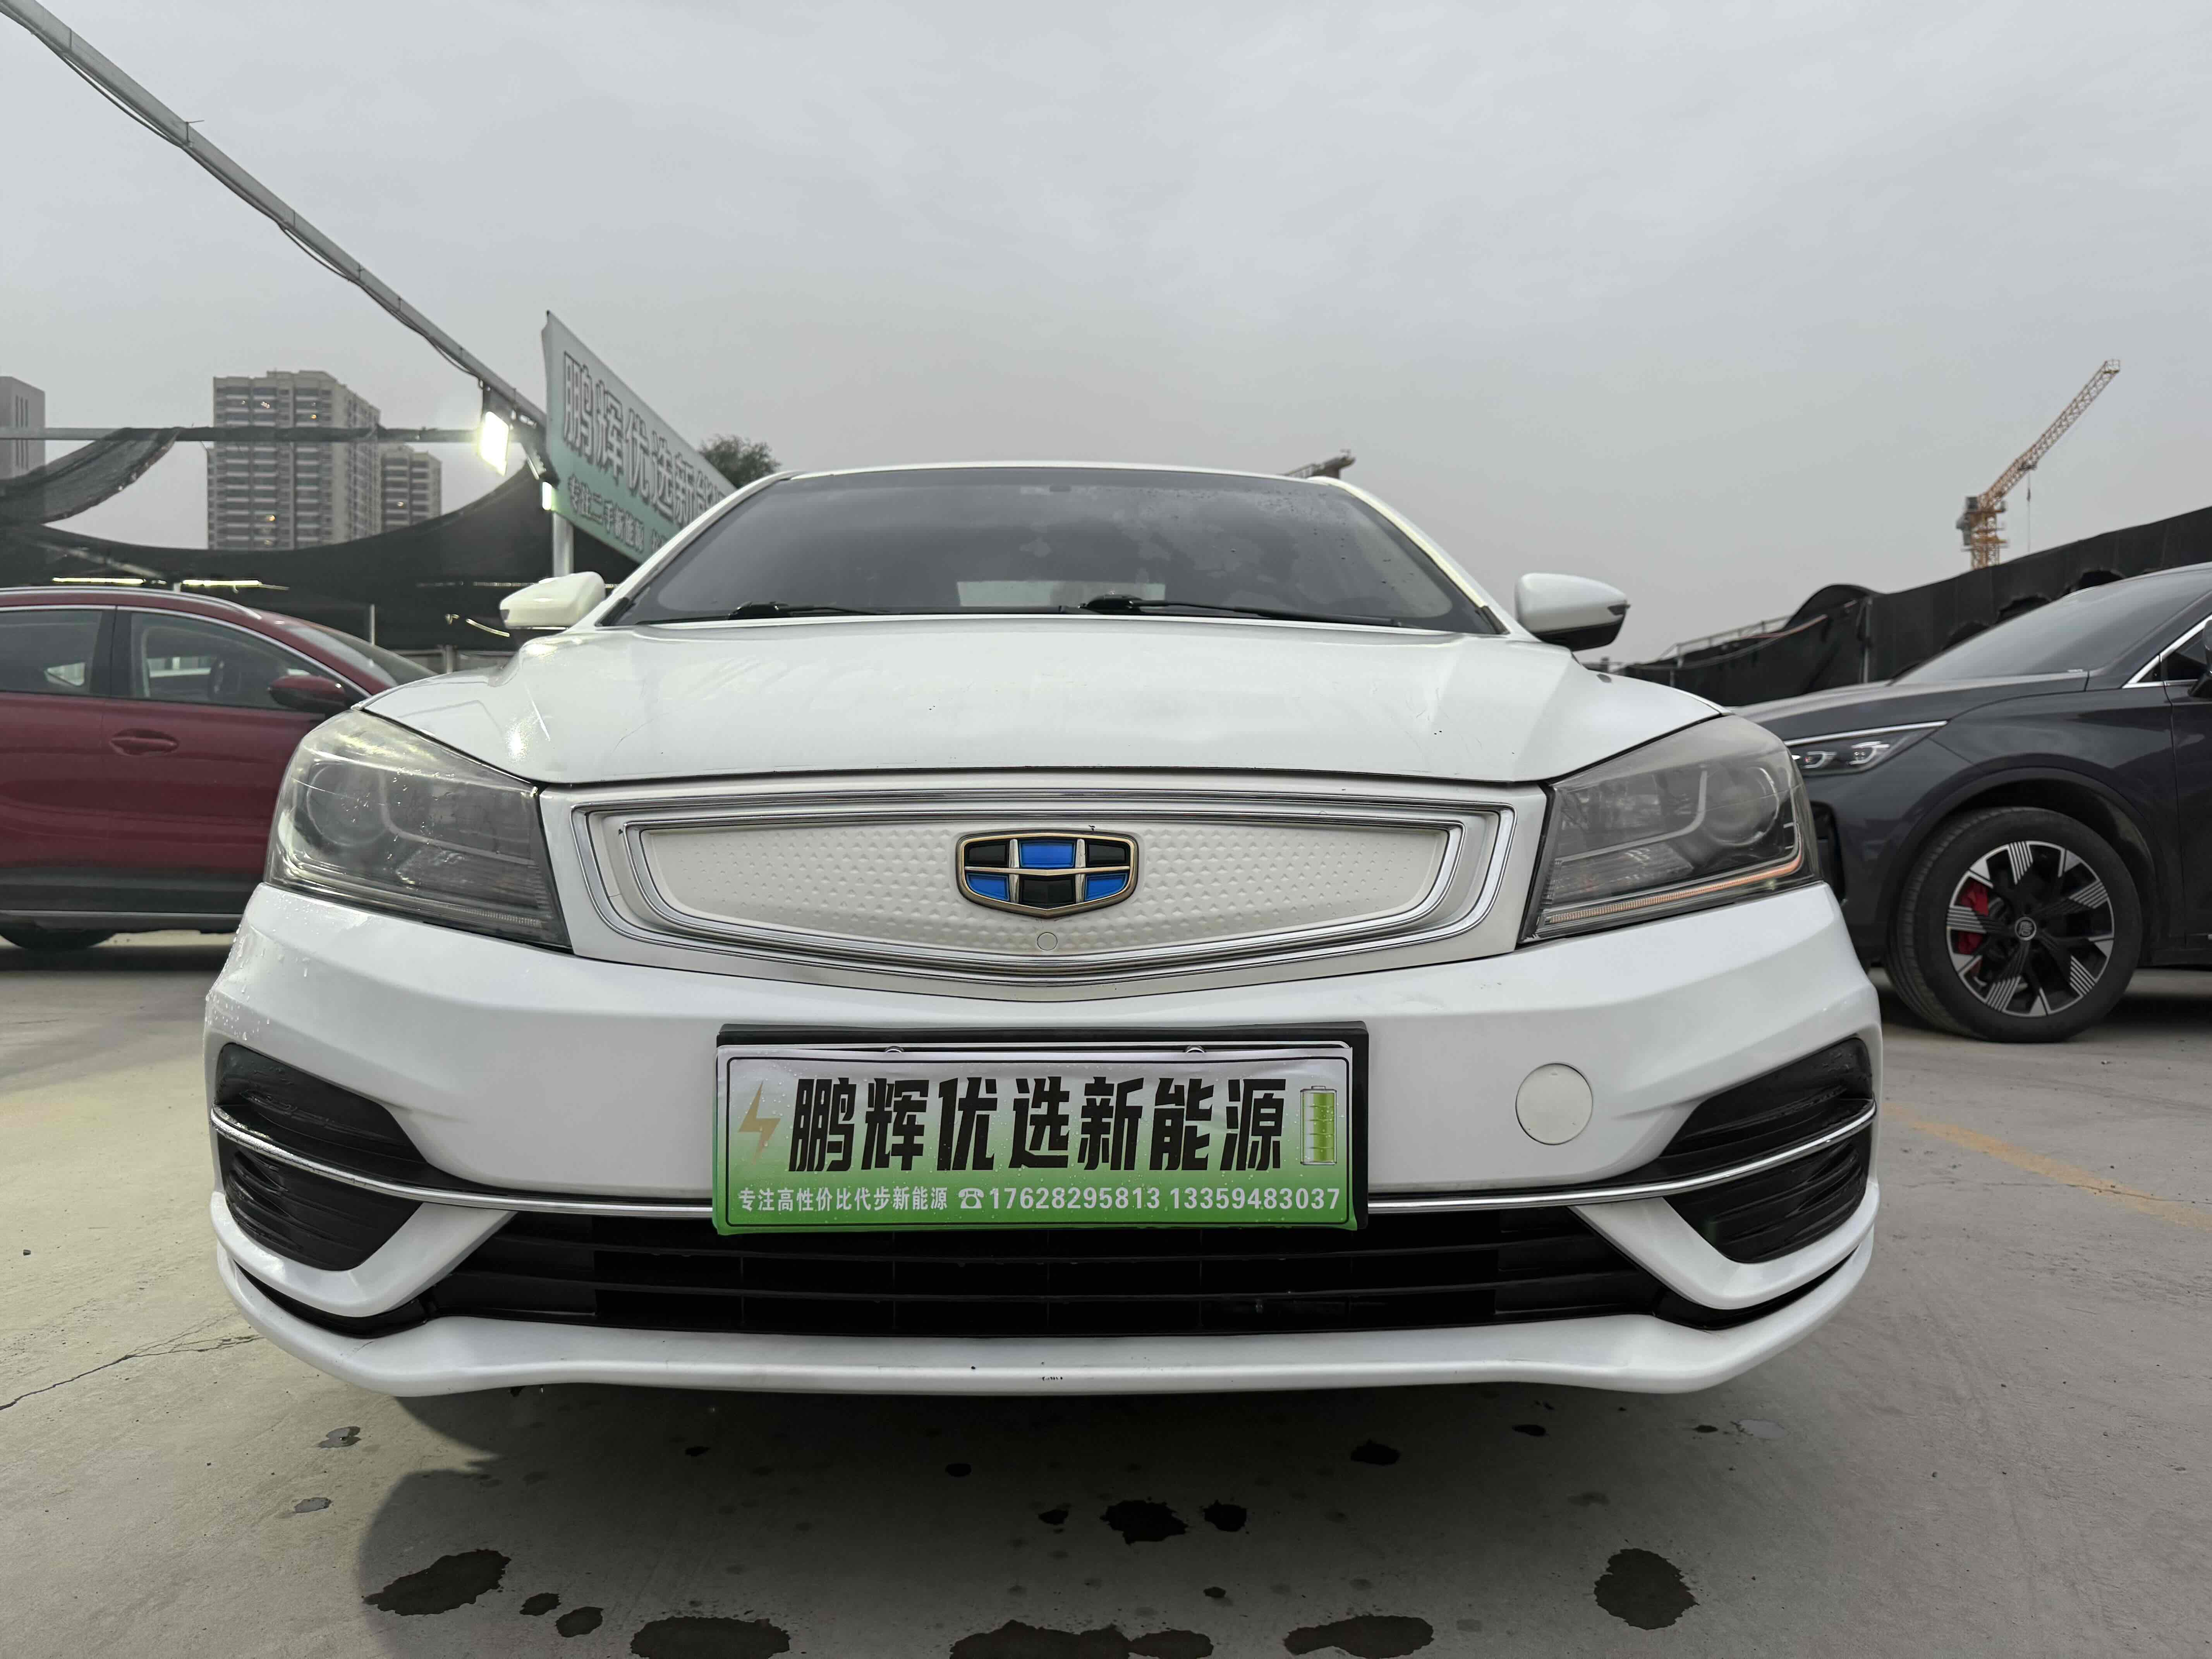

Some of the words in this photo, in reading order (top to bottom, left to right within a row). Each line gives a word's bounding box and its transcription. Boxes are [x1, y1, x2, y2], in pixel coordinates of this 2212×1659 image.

[563, 350, 726, 528] 鹏辉优选新能
[789, 1076, 1286, 1172] 鹏辉优选新能源
[738, 1187, 948, 1211] 专注高性价比代步新能源
[989, 1187, 1160, 1210] 17628295813
[1170, 1187, 1340, 1210] 13359483037
